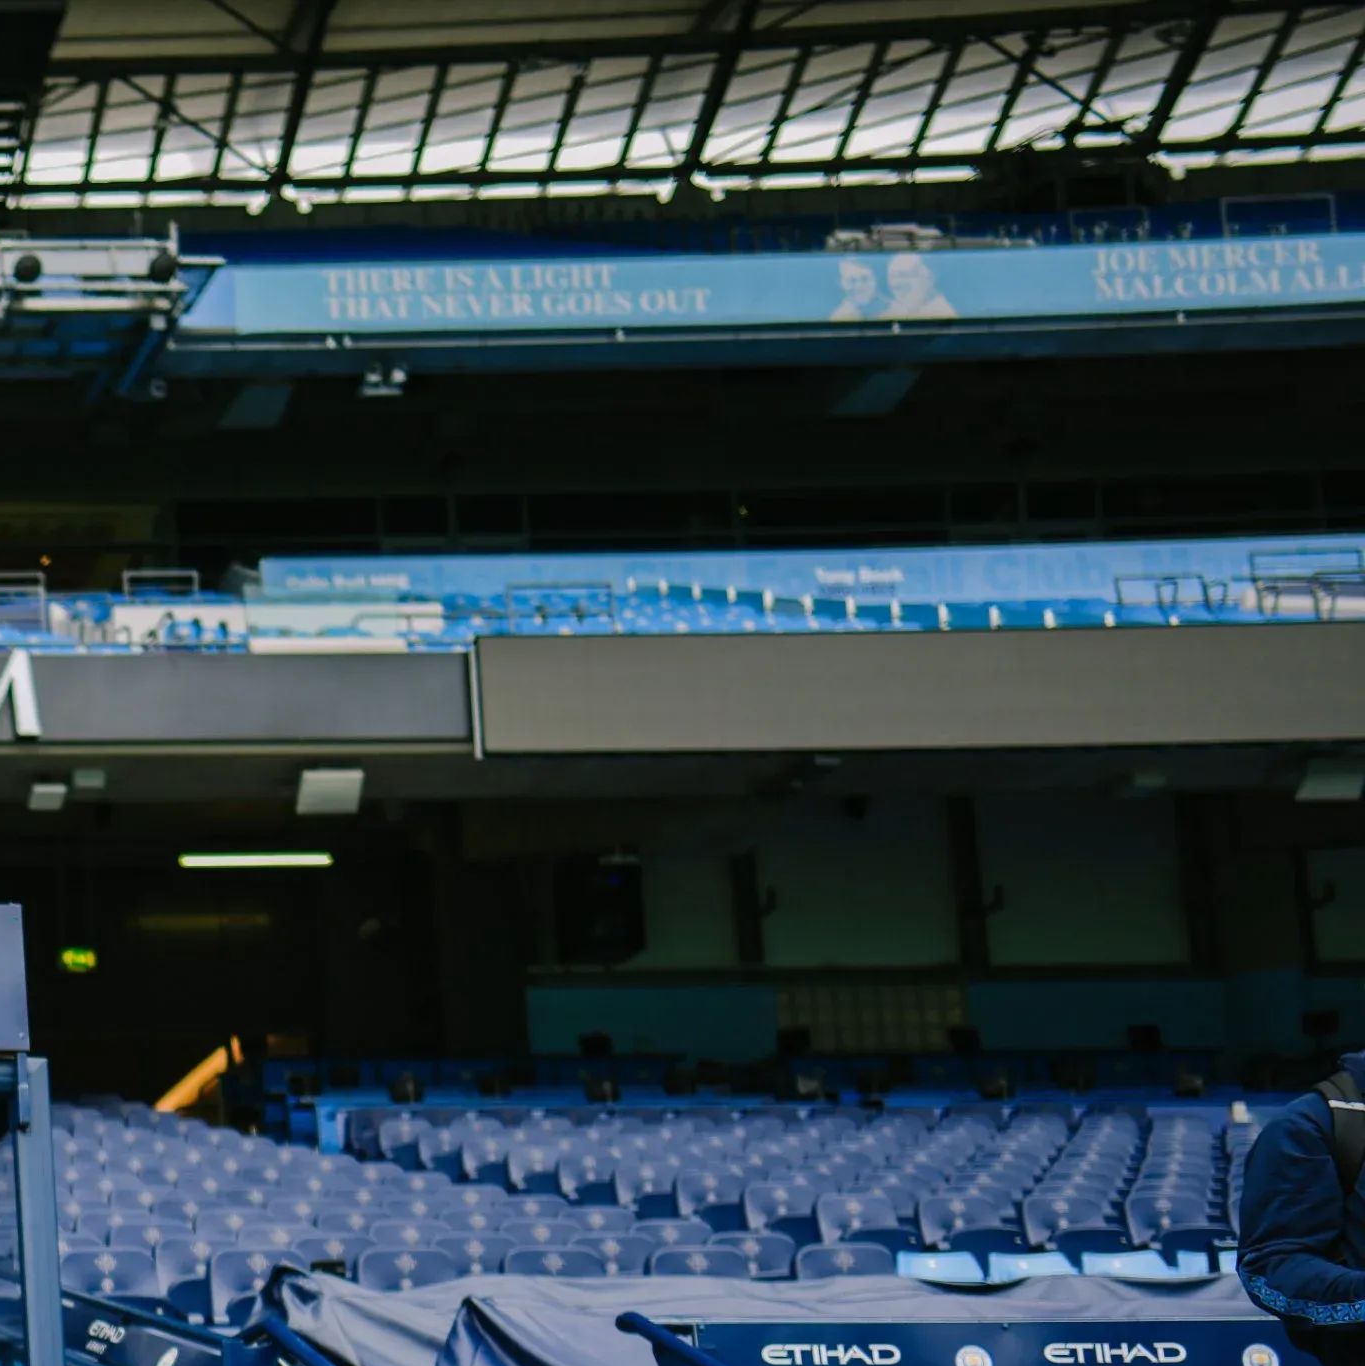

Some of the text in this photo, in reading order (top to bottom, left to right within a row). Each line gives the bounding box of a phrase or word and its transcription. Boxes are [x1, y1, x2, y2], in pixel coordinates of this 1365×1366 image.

[1095, 240, 1319, 273] JOE MERCER
[323, 264, 617, 293] THERE IS A LIGHT
[1095, 269, 1280, 300] MALCOLM
[325, 288, 712, 320] THAT NEVER GOES OUT
[761, 1344, 902, 1365] ETIHAD
[1043, 1342, 1187, 1364] ETIHAD
